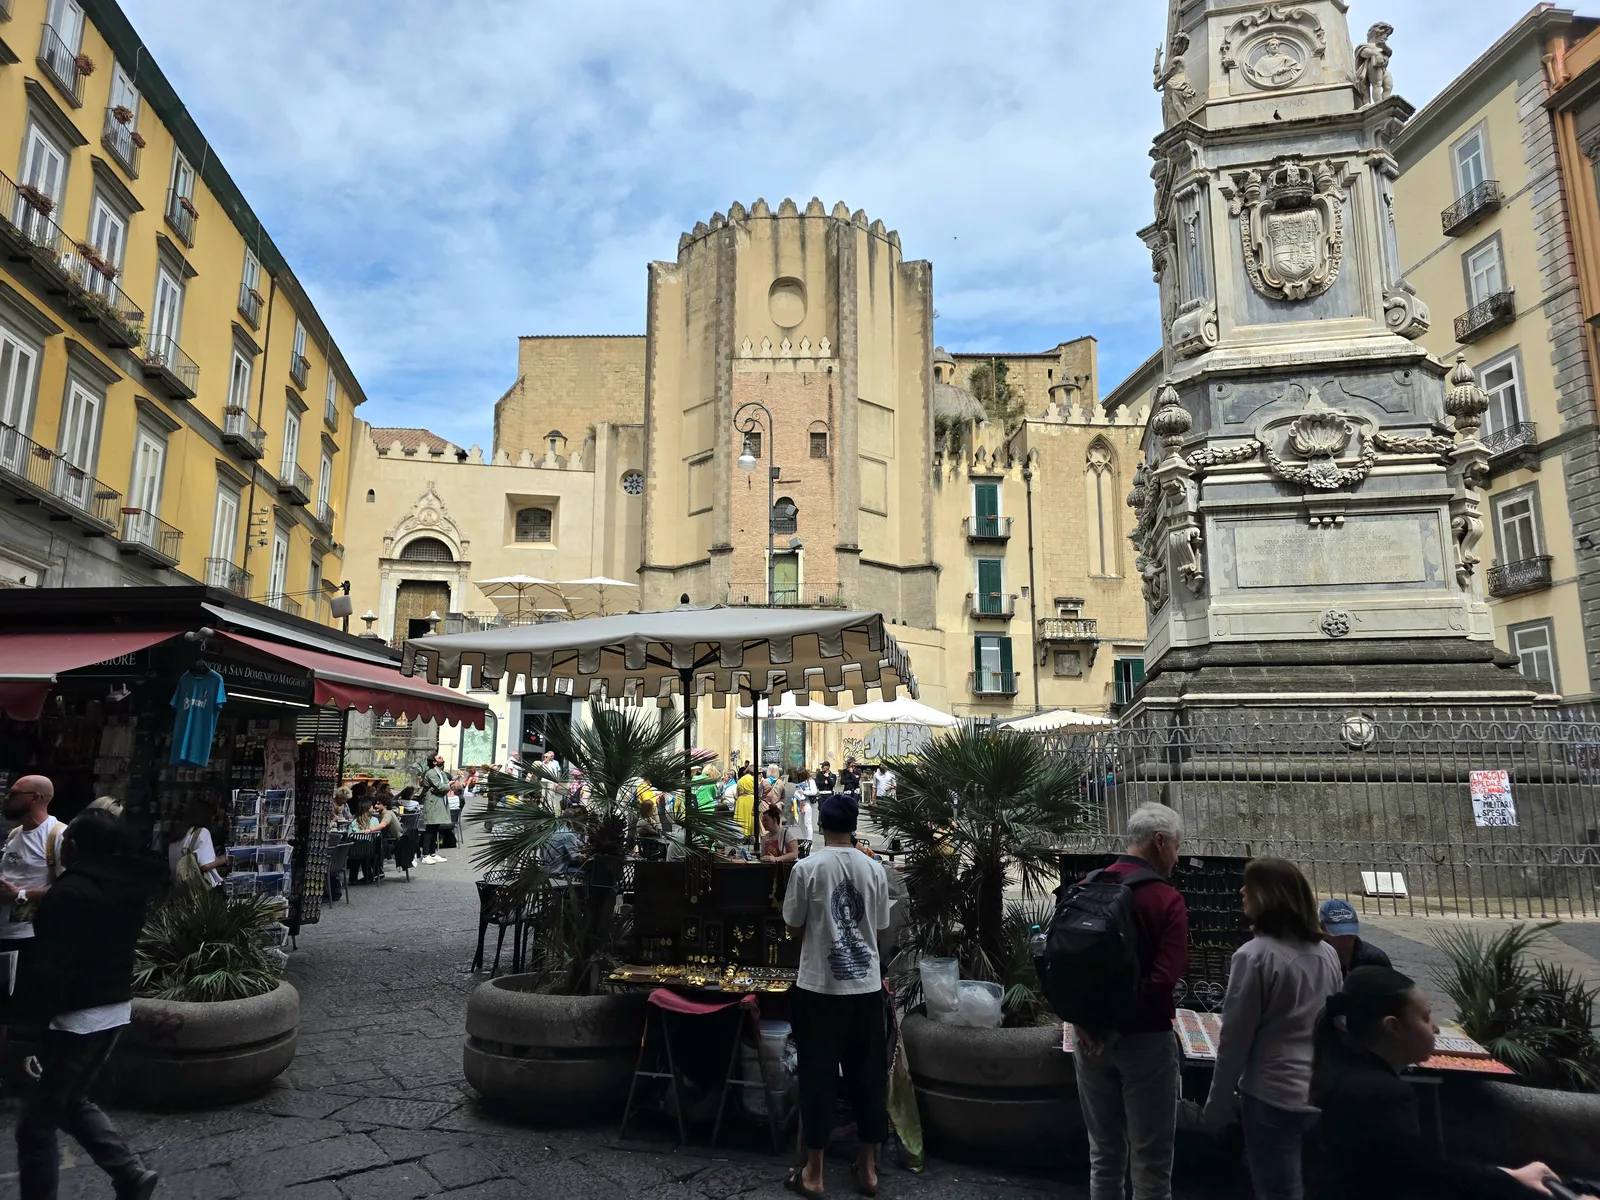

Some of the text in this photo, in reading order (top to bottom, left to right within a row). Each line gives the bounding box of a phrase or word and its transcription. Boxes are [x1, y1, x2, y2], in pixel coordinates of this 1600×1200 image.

[244, 667, 278, 683] DOMENICO
[1476, 770, 1506, 780] MAGGIO
[1483, 800, 1512, 809] MILITARI
[1482, 808, 1506, 817] SPESE
